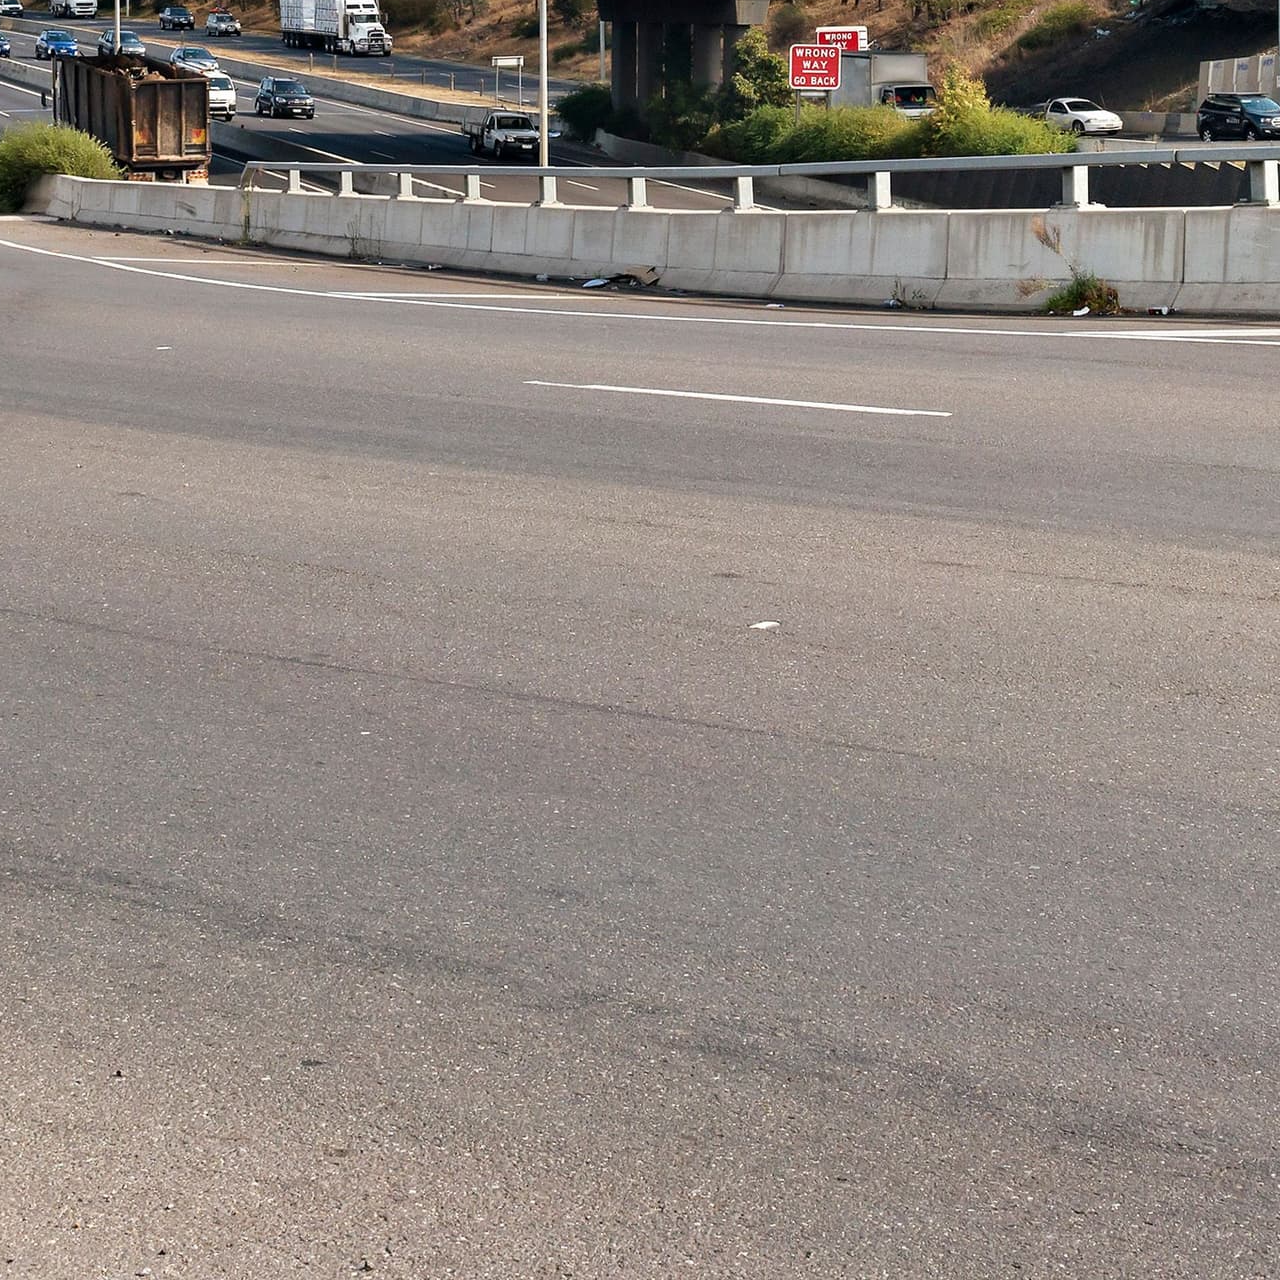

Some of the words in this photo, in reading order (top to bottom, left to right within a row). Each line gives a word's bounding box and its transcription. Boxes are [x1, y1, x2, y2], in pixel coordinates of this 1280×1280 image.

[795, 48, 836, 58] WRONG
[802, 60, 828, 69] WAY
[793, 76, 806, 85] GO
[811, 76, 836, 86] BACK
